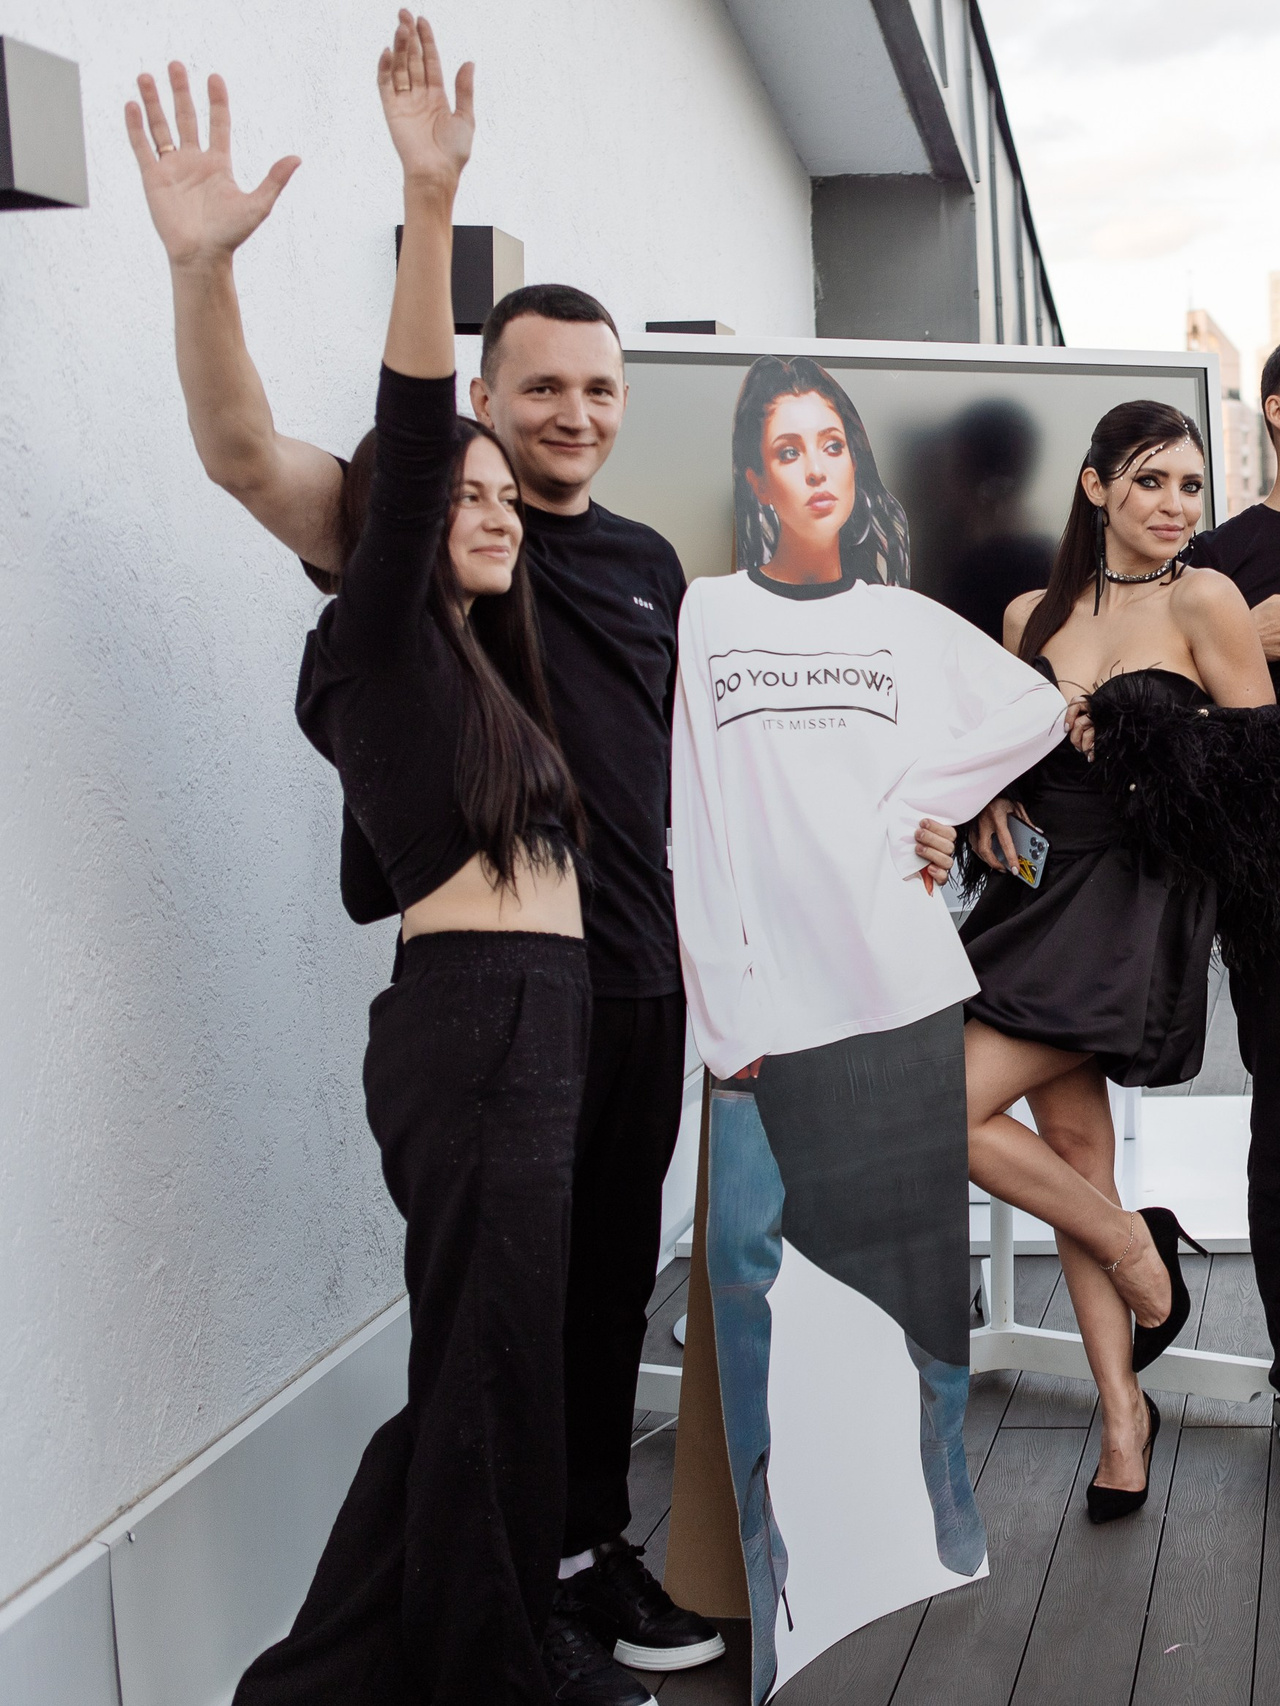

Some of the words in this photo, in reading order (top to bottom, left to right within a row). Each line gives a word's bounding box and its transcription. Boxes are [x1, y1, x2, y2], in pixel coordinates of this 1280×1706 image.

[715, 672, 742, 702] DO
[746, 668, 799, 687] YOU
[807, 667, 894, 697] KNOW?
[789, 717, 847, 730] MISSTA
